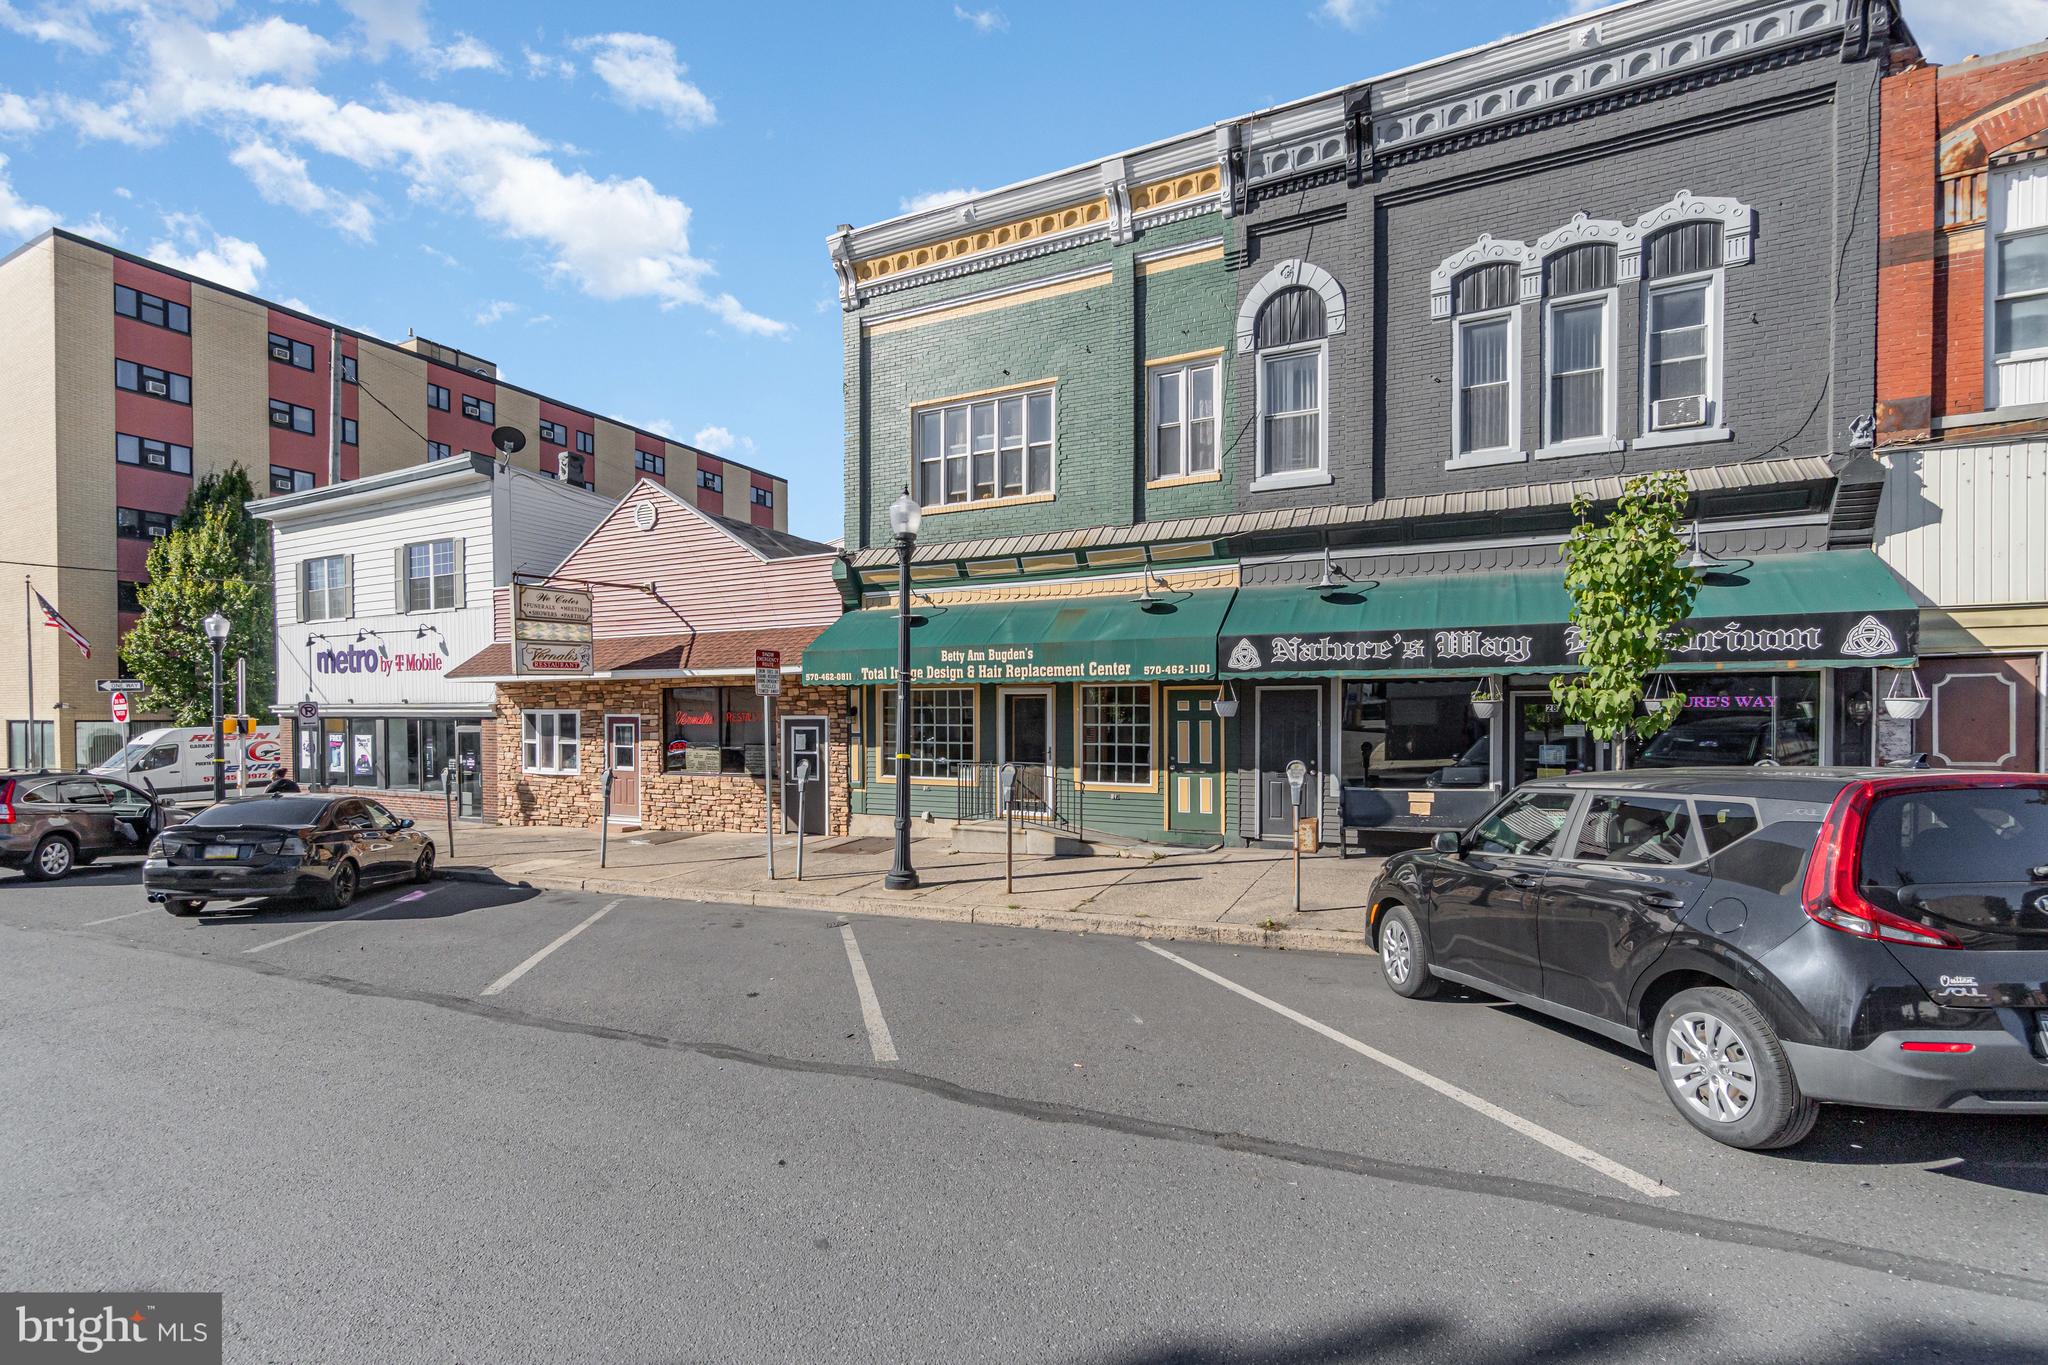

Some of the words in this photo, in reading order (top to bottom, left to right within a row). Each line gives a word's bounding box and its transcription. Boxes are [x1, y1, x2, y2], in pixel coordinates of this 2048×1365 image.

[526, 602, 556, 610] FUNERALS
[1271, 633, 1424, 663] Nature's
[1435, 630, 1533, 662] Way
[317, 644, 379, 674] metro
[380, 655, 393, 677] by
[941, 649, 965, 664] Betty
[967, 649, 985, 661] Ann
[988, 648, 1033, 663] Bugden's
[861, 666, 887, 680] Total
[890, 666, 933, 681] Ige
[926, 665, 963, 681] Design
[967, 665, 975, 678] &
[979, 664, 1003, 678] Hair
[1005, 662, 1085, 680] Replacement
[1089, 661, 1131, 676] Center
[1143, 663, 1210, 675] 570-462-1101
[805, 672, 852, 681] 570-462-0811
[1735, 696, 1777, 708] WAY
